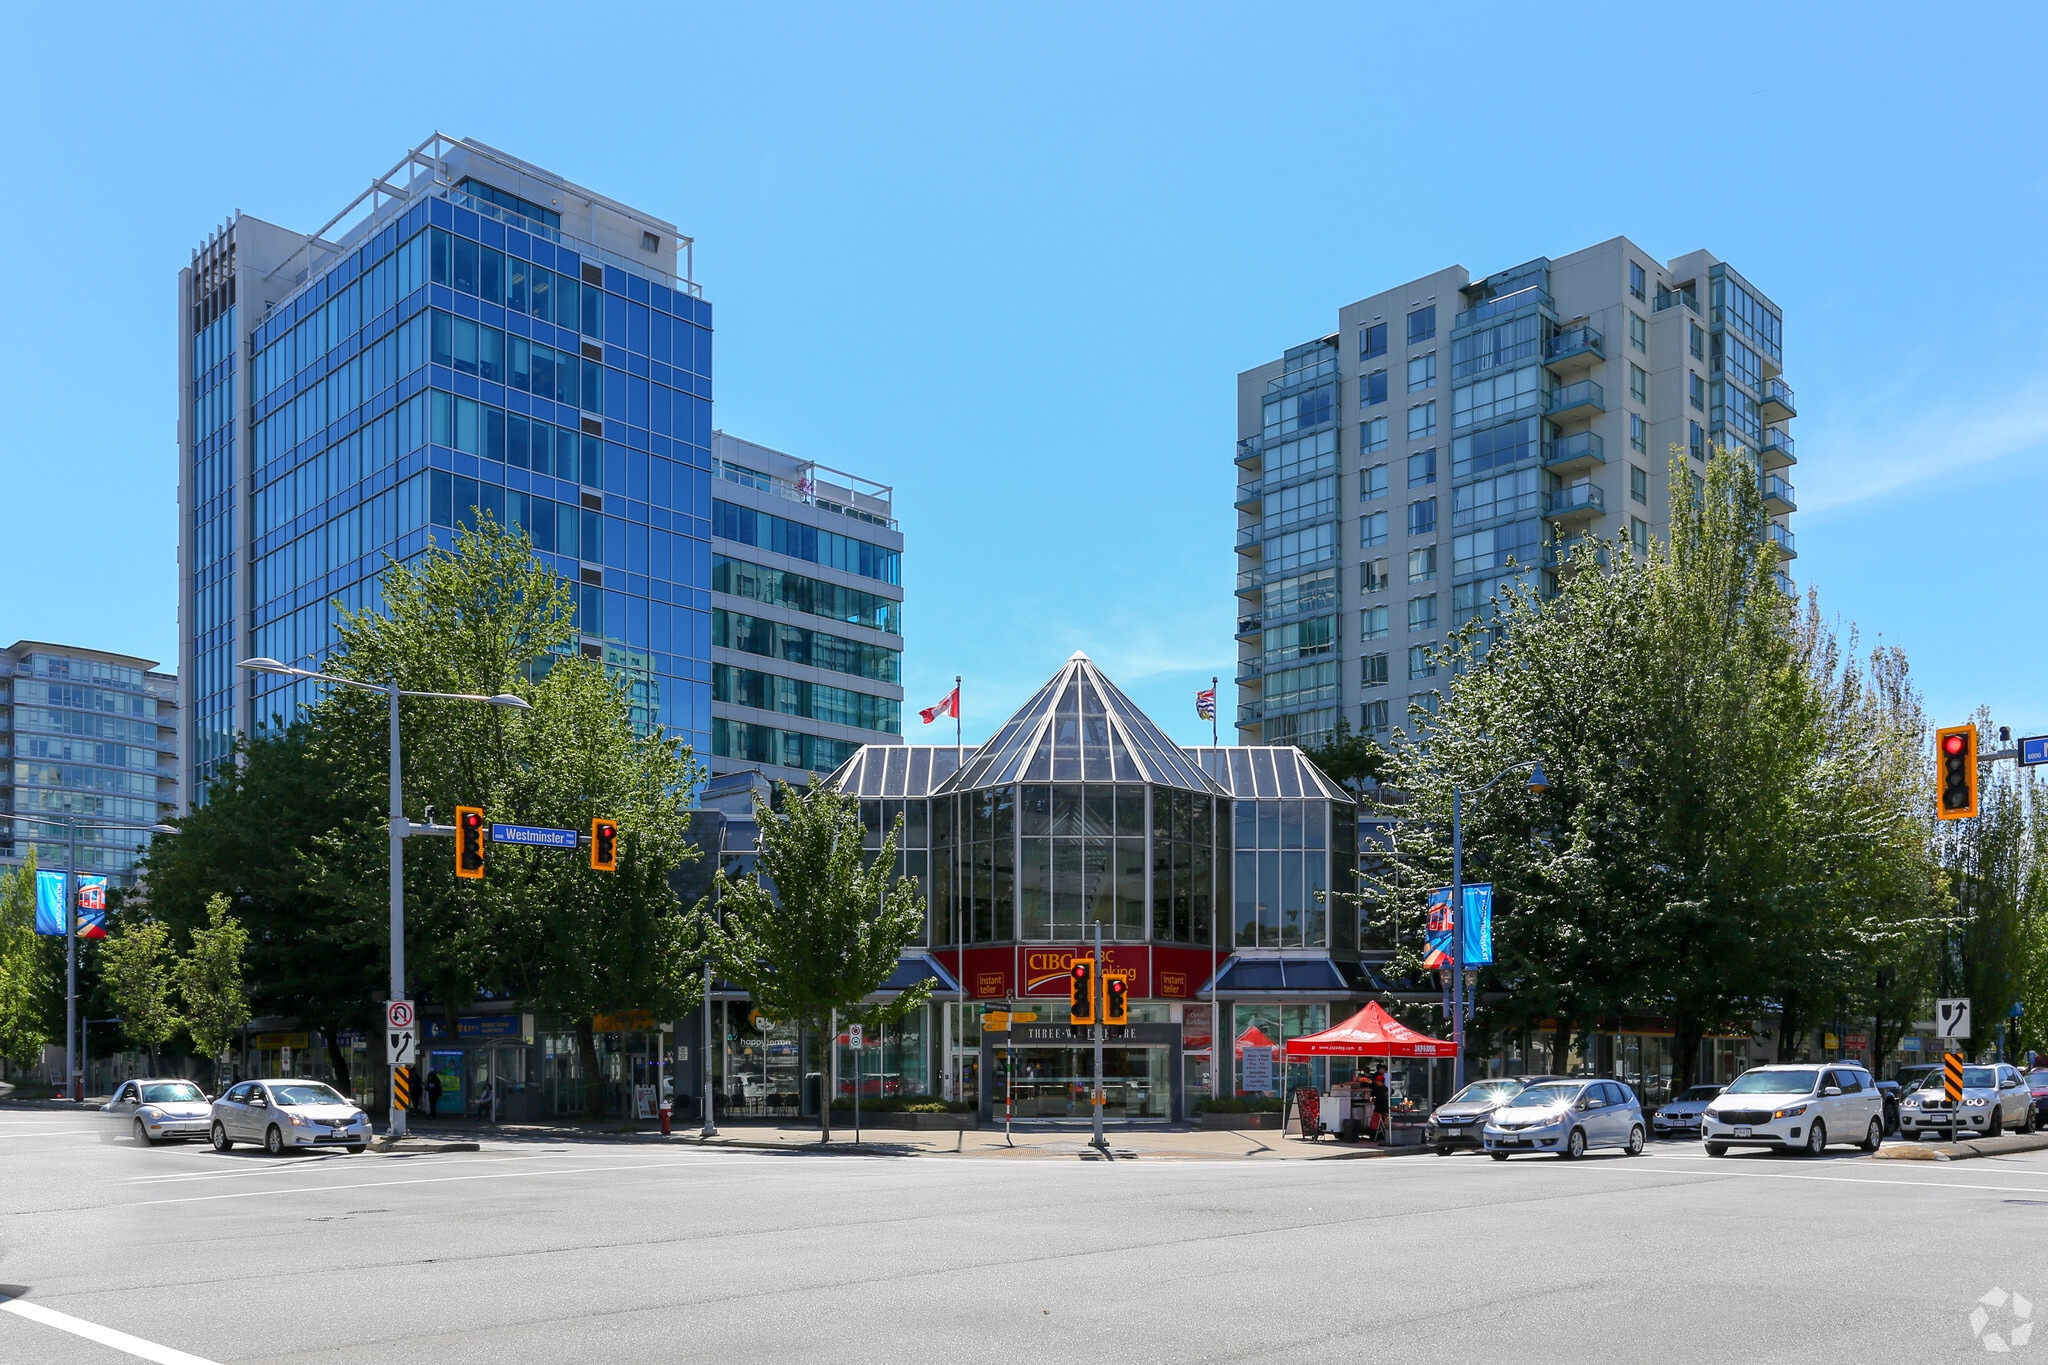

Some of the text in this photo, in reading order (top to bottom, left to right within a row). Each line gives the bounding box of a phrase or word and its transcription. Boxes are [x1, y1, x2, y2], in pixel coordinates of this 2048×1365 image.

[505, 828, 564, 844] Westminster
[1029, 953, 1073, 970] CIBC
[1101, 965, 1137, 981] nking
[980, 976, 1001, 985] Instant
[1164, 975, 1184, 985] Instant
[980, 985, 996, 994] teller
[1163, 985, 1179, 994] teller
[1028, 1028, 1061, 1039] THREE
[1414, 1045, 1436, 1053] JAPADOG
